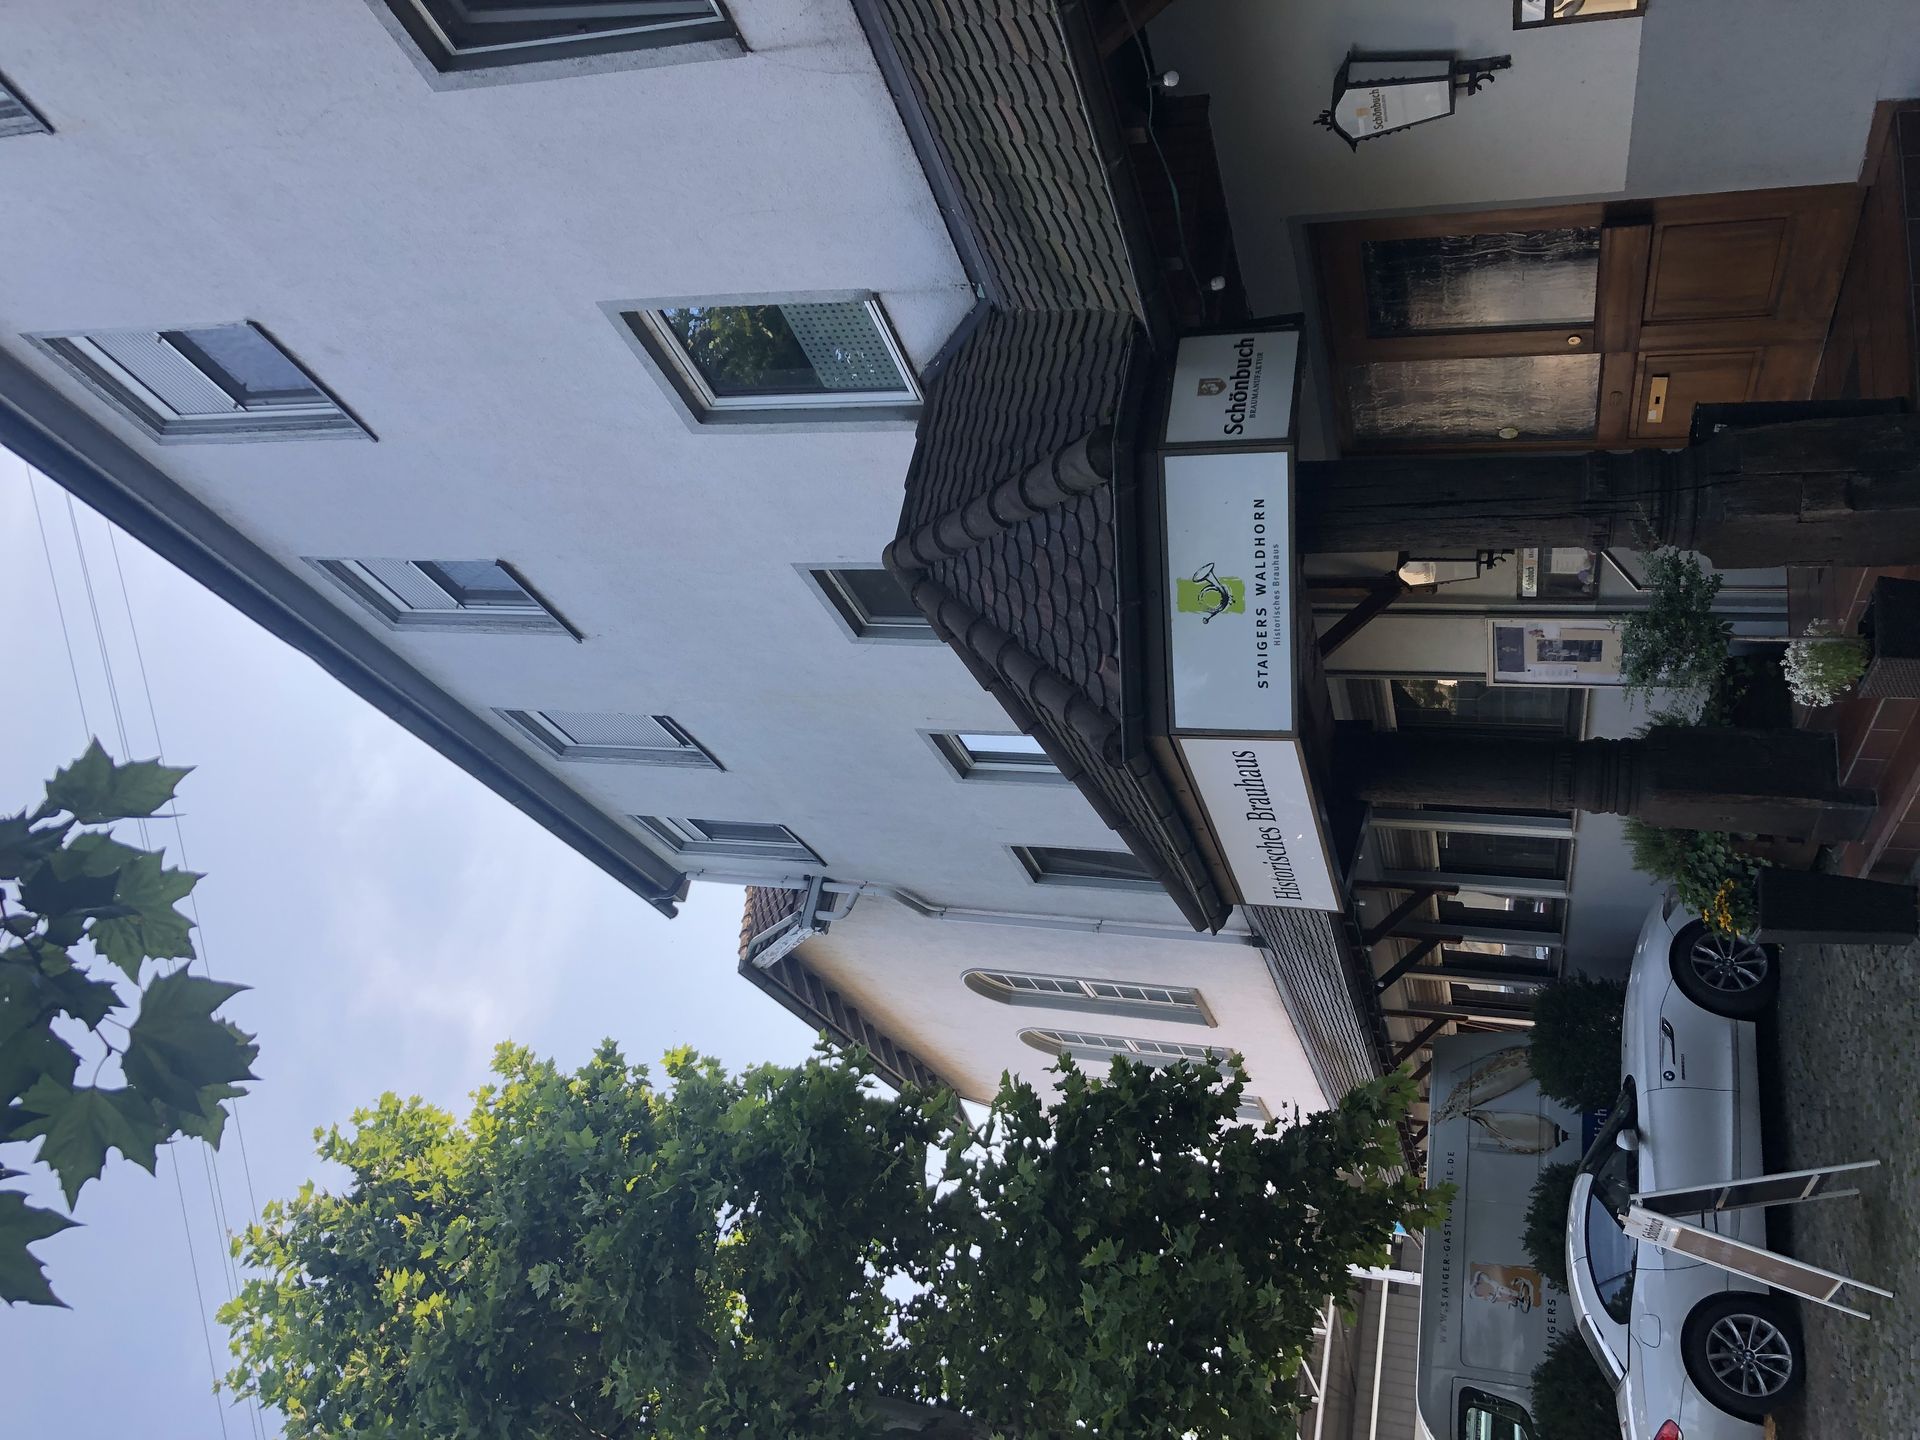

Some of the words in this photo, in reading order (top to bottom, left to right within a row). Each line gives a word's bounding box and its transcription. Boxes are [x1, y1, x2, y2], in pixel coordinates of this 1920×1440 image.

[1369, 88, 1384, 130] Schönbuch
[1223, 337, 1255, 436] Schönbuch
[1248, 352, 1264, 419] BRAUMANUFAKTUR
[1253, 498, 1267, 596] WALDHORN
[1271, 543, 1280, 587] Brauhaus
[1255, 607, 1269, 689] STAIGERS
[1272, 590, 1281, 646] Historisches
[1231, 750, 1277, 822] Brauhaus
[1255, 826, 1303, 901] Historisches
